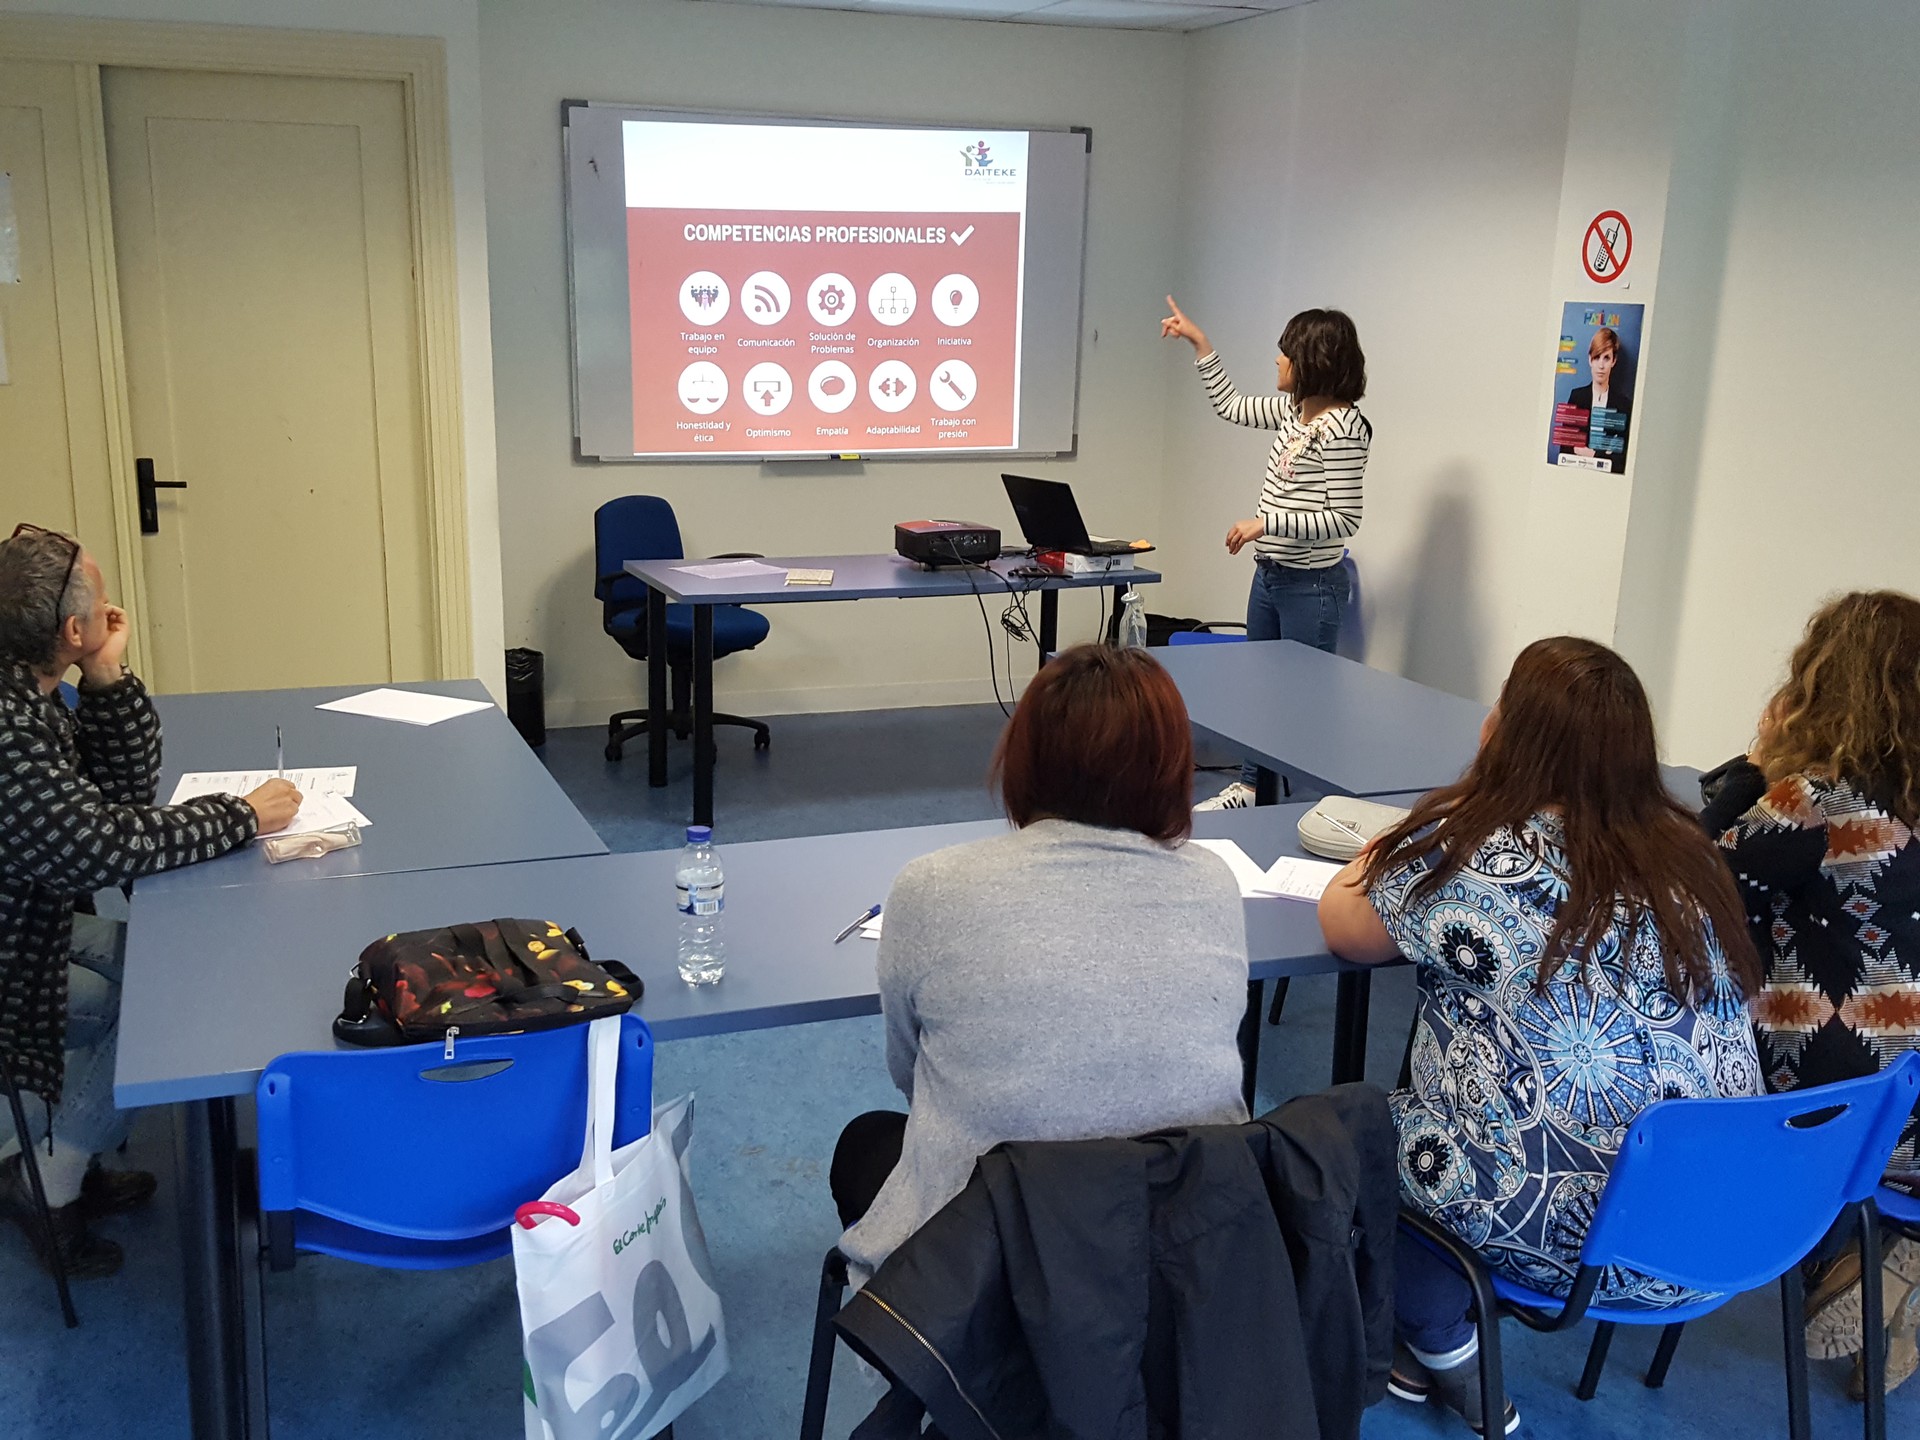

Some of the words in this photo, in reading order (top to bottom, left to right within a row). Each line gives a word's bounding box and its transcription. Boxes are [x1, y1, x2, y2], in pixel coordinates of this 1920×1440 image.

[964, 168, 1017, 177] DAITEKE
[683, 223, 811, 243] COMPETENCIAS
[815, 227, 946, 244] PROFESIONALES
[680, 332, 712, 343] Trabajo
[737, 337, 796, 347] Comunicación
[809, 332, 844, 342] Solución
[845, 332, 856, 341] de
[937, 337, 972, 346] Iniciativa
[867, 337, 920, 349] Organización
[688, 345, 718, 356] equipo
[811, 345, 854, 354] Problemas
[676, 421, 725, 431] Honestidad
[725, 423, 732, 432] y
[931, 417, 961, 428] Trabajo
[962, 419, 977, 427] con
[746, 428, 791, 439] Optimismo
[816, 426, 849, 437] Empatía
[866, 426, 921, 436] Adaptabilidad
[938, 429, 968, 441] presión
[693, 433, 714, 443] ética
[612, 1238, 624, 1255] El
[622, 1222, 646, 1247] Corte
[644, 1196, 667, 1235] Inglés
